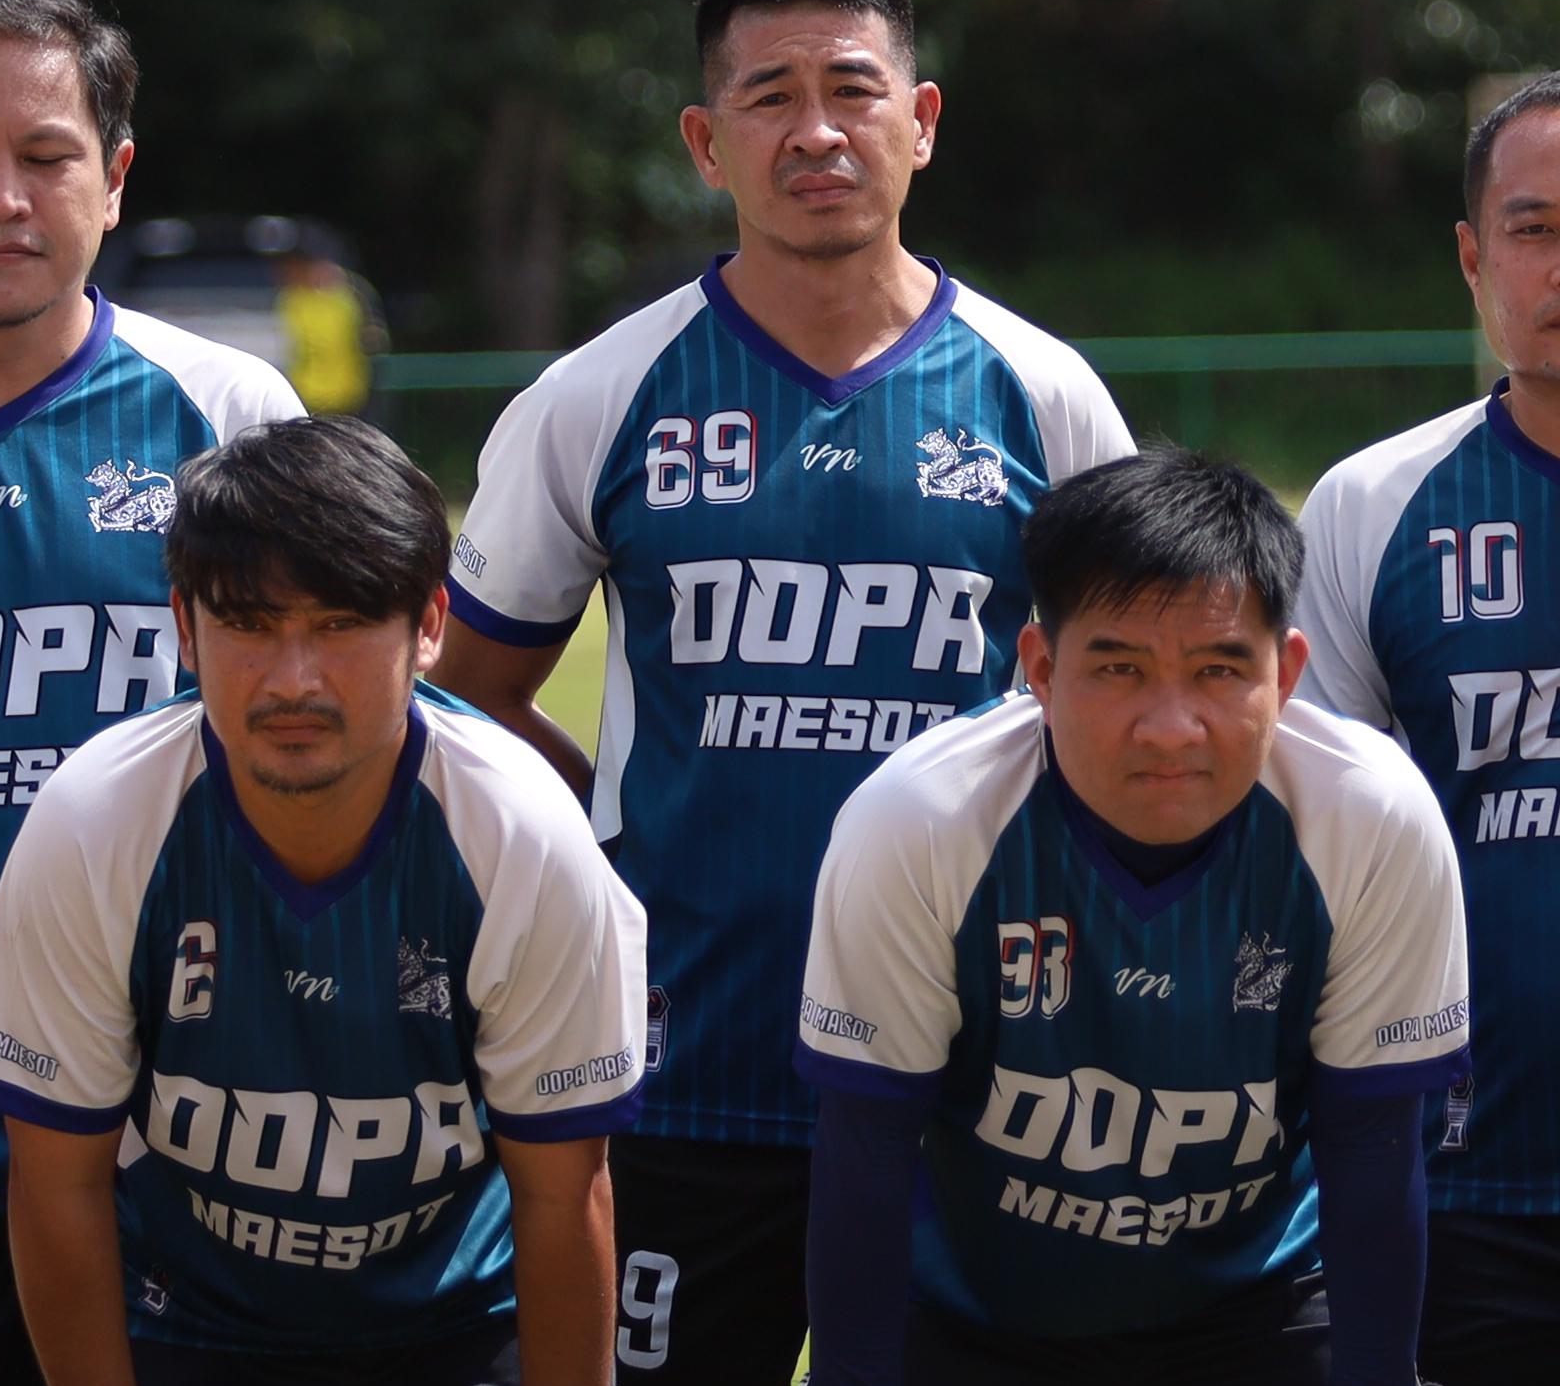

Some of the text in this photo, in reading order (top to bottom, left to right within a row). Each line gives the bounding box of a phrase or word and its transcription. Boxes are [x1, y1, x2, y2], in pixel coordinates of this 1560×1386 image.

[642, 407, 758, 511] 69
[453, 533, 488, 581] AESOT
[1427, 520, 1525, 623] 10
[665, 558, 995, 675] DOPA
[146, 1070, 486, 1199] DOPA
[187, 1187, 455, 1271] MAESOT
[998, 1171, 1276, 1246] MAESOT
